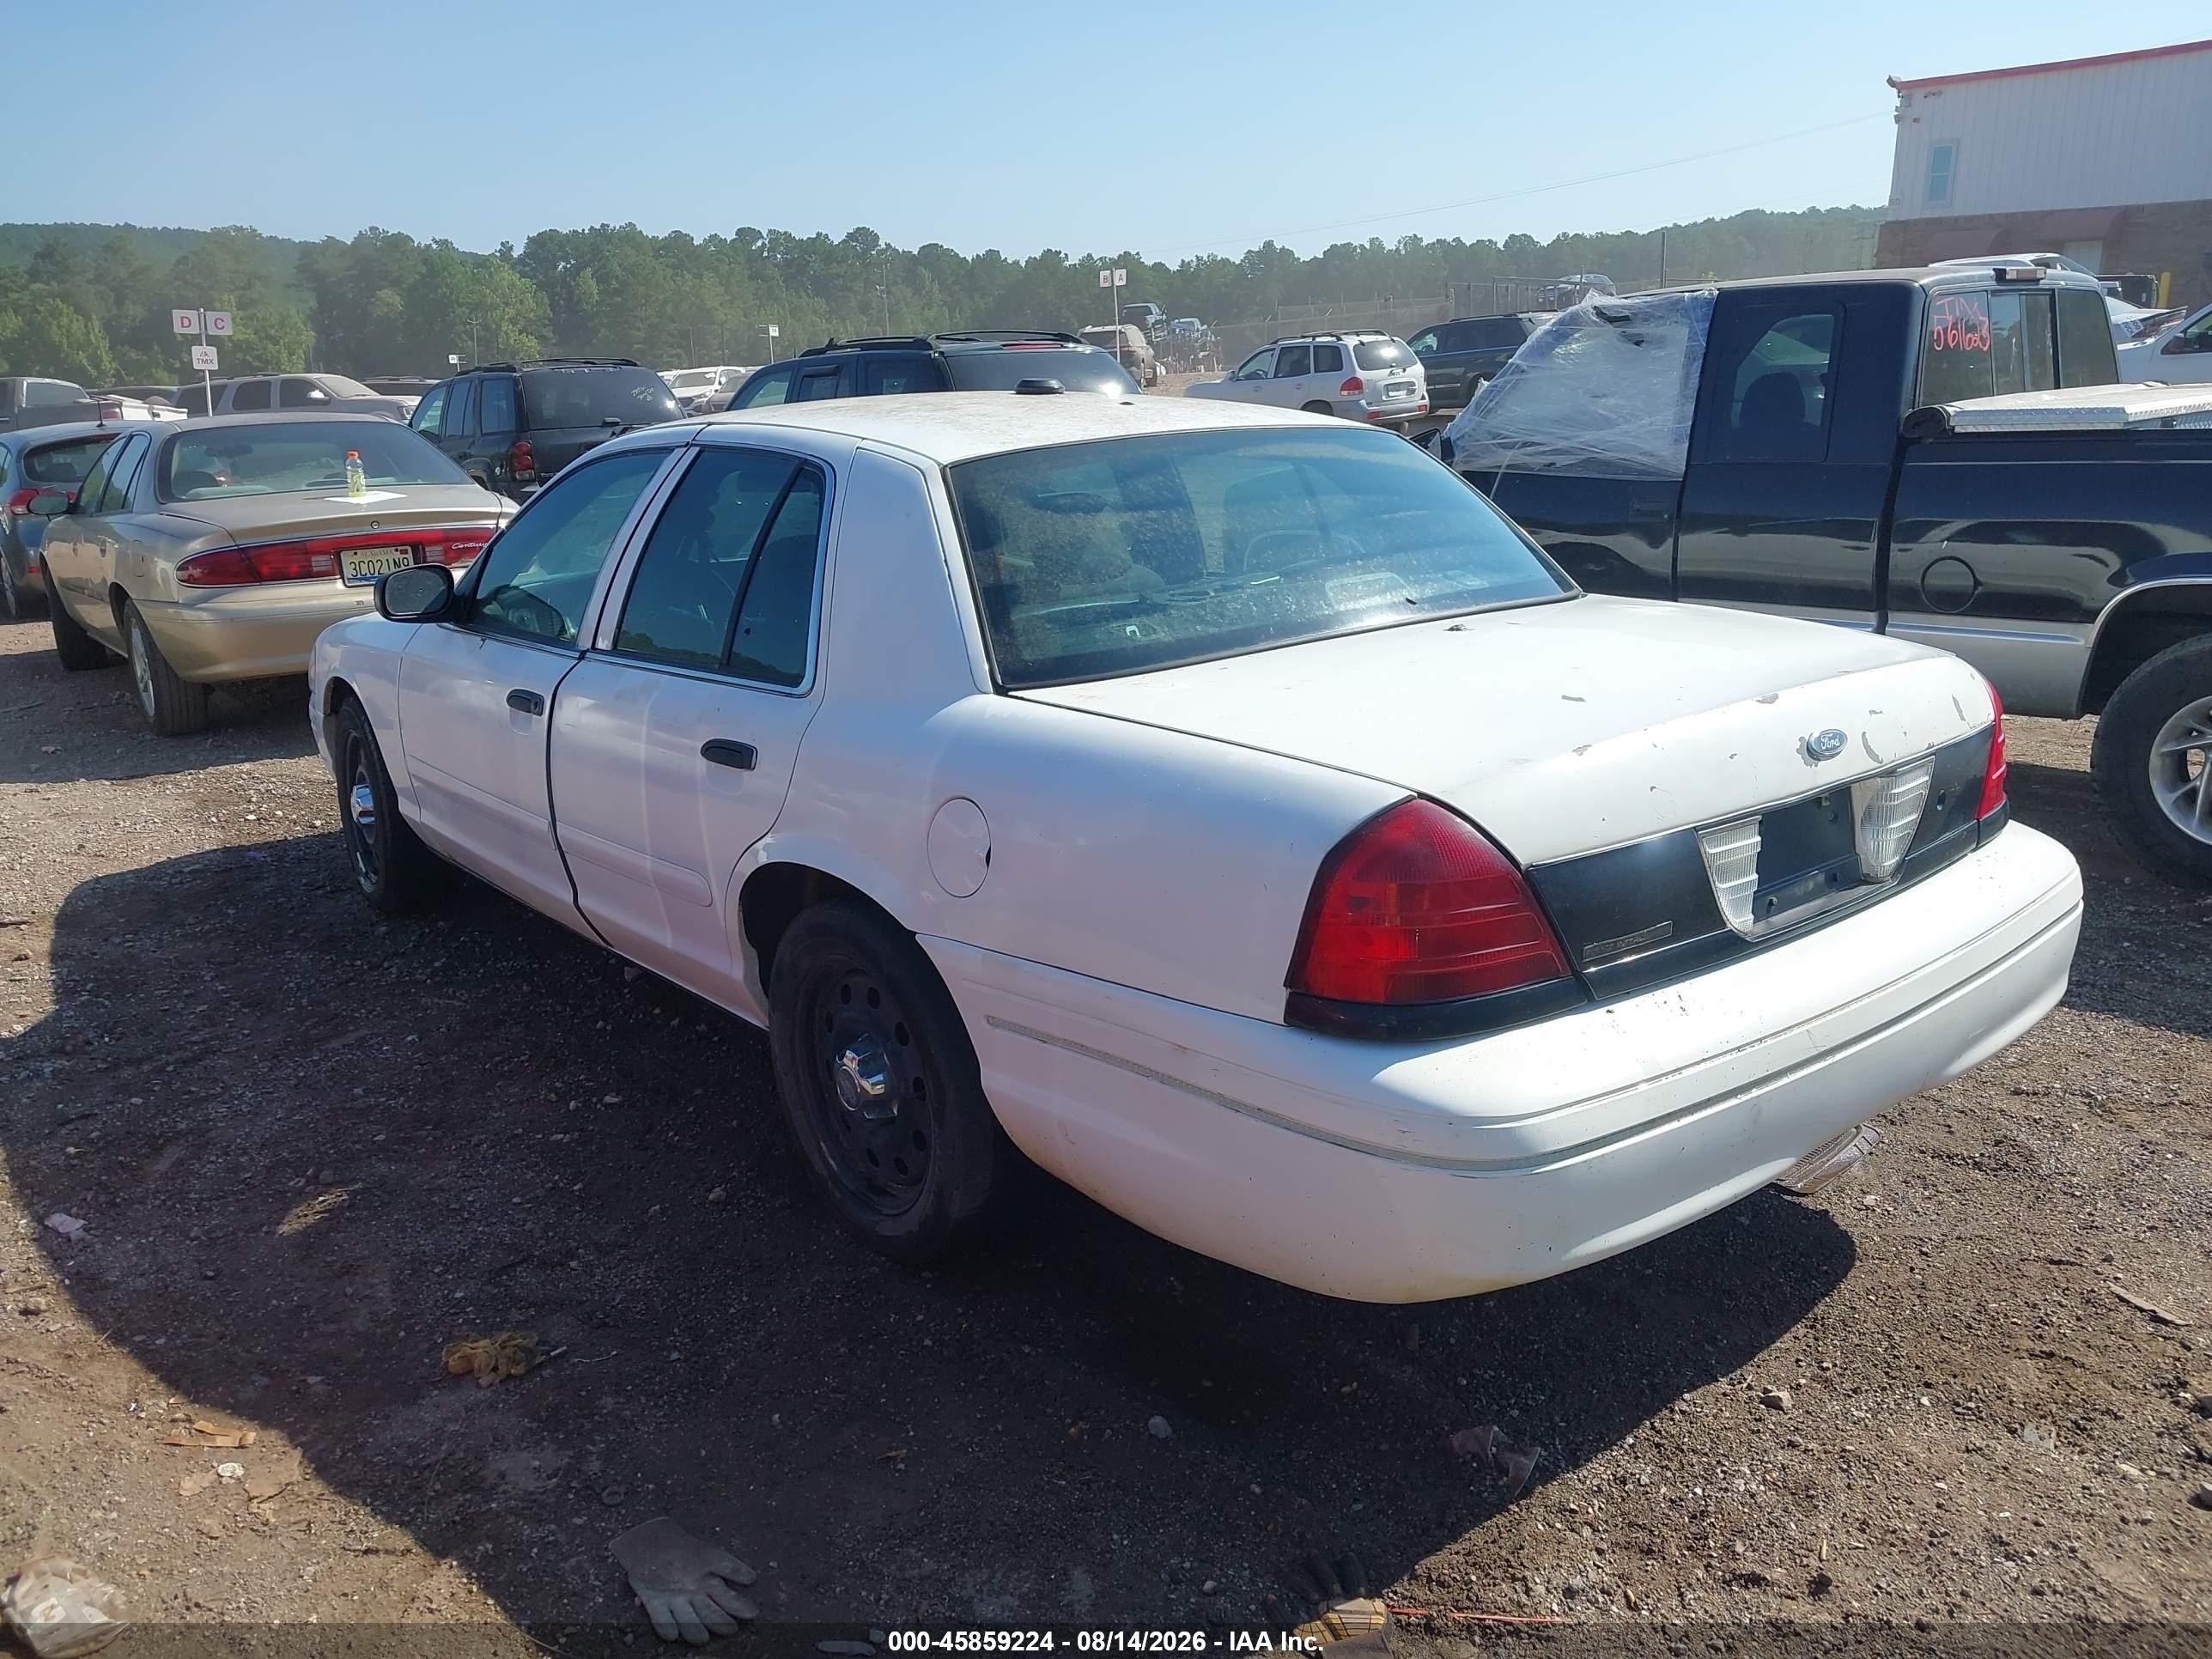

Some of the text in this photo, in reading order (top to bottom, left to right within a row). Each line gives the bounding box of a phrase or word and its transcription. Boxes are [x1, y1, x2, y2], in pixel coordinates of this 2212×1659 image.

[1103, 275, 1109, 283] B
[1118, 273, 1124, 283] A
[179, 316, 191, 328] D
[214, 317, 225, 330] C
[1820, 732, 1841, 750] Ford
